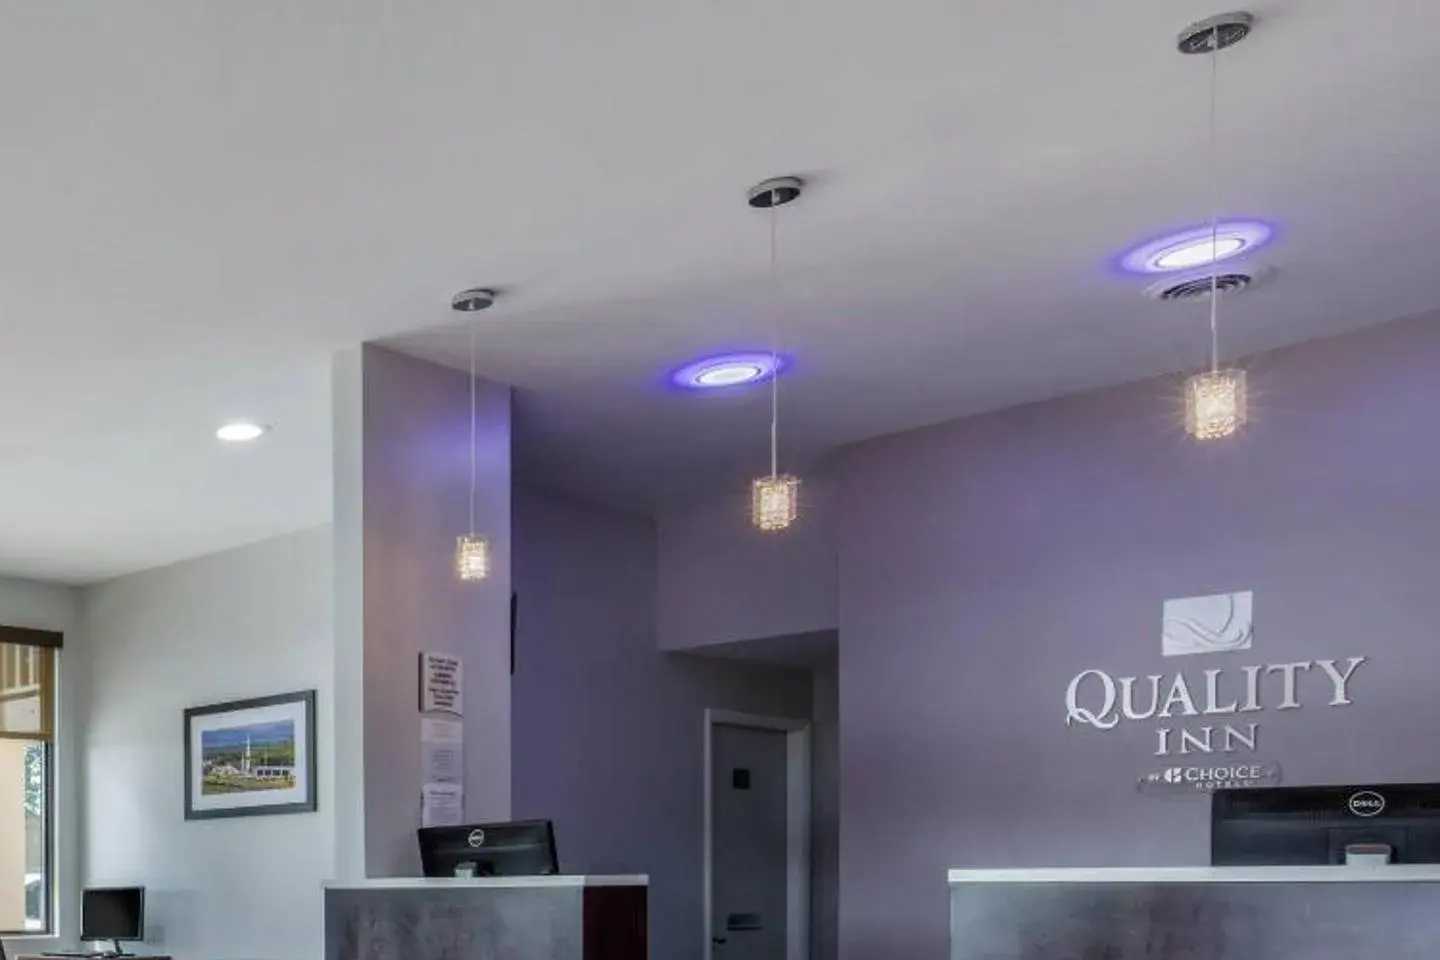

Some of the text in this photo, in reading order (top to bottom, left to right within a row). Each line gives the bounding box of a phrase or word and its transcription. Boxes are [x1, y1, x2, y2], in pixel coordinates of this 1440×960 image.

[1066, 656, 1365, 729] QUALITY
[1154, 724, 1259, 756] INN
[1185, 765, 1261, 781] CHOICE
